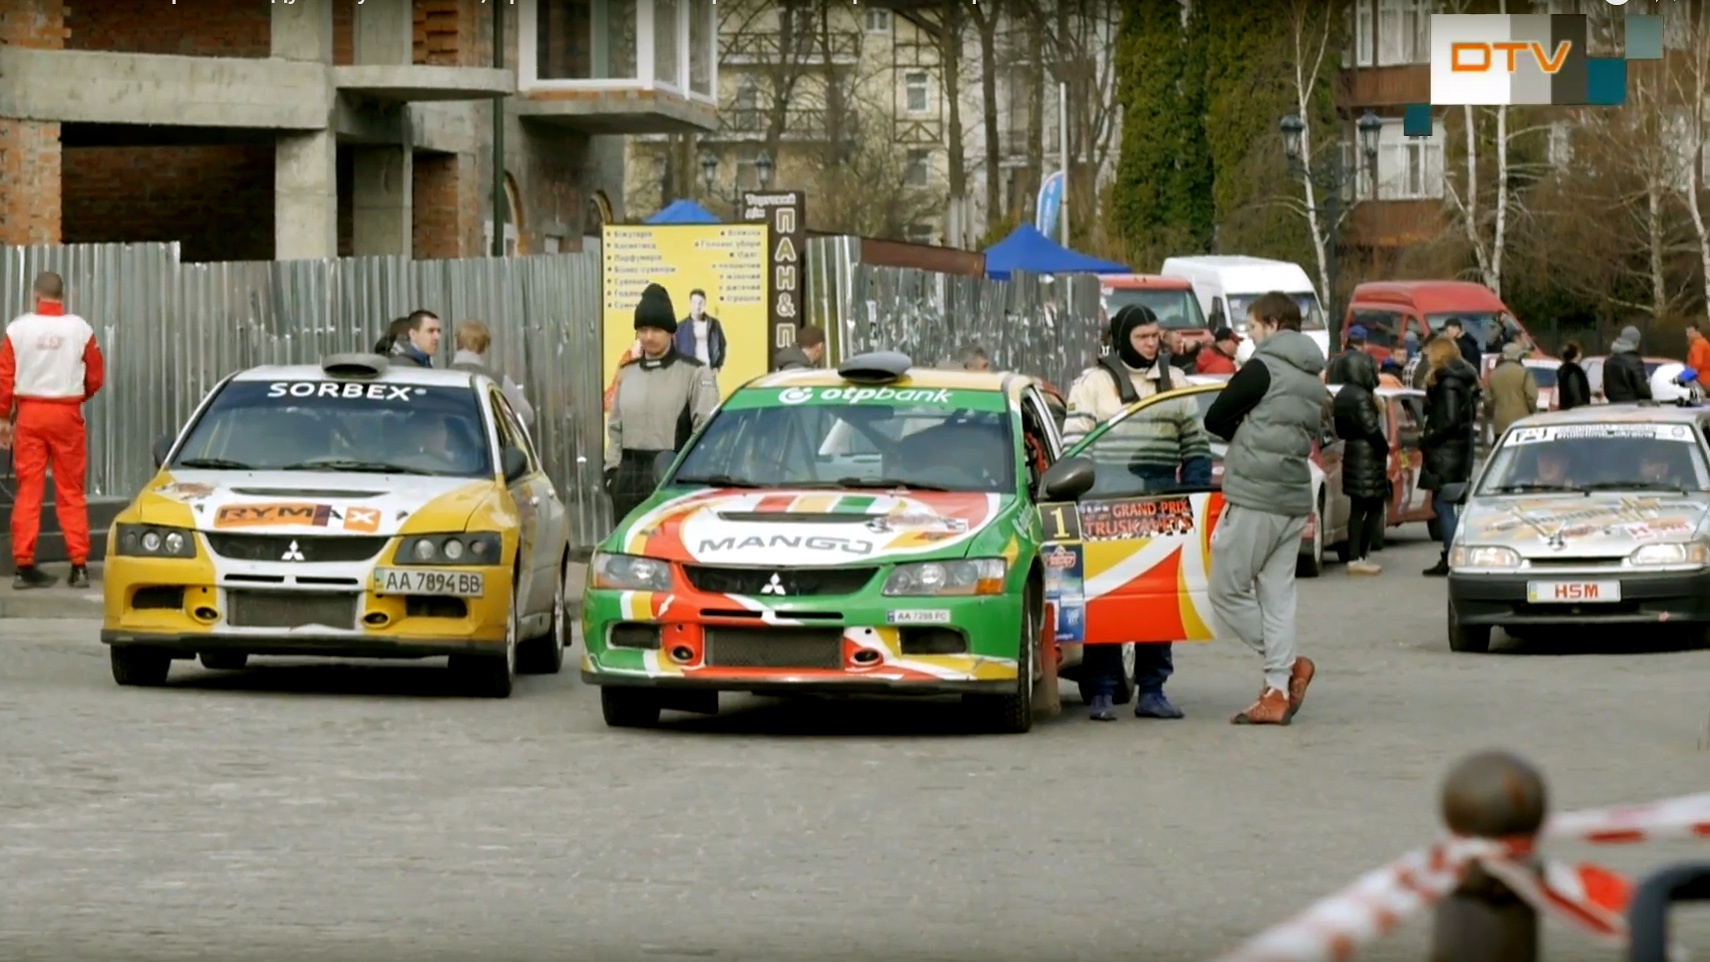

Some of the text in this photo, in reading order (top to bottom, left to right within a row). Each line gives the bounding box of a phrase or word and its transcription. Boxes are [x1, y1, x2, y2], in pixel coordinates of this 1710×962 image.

[820, 386, 953, 405] otpbank
[219, 505, 378, 526] RYMAX
[1112, 501, 1157, 518] GRAND
[1160, 500, 1189, 514] PRIX
[1050, 506, 1071, 538] 1
[698, 534, 874, 555] MANGO
[386, 571, 412, 590] AA
[416, 572, 456, 593] 7894
[1554, 584, 1599, 599] HSM
